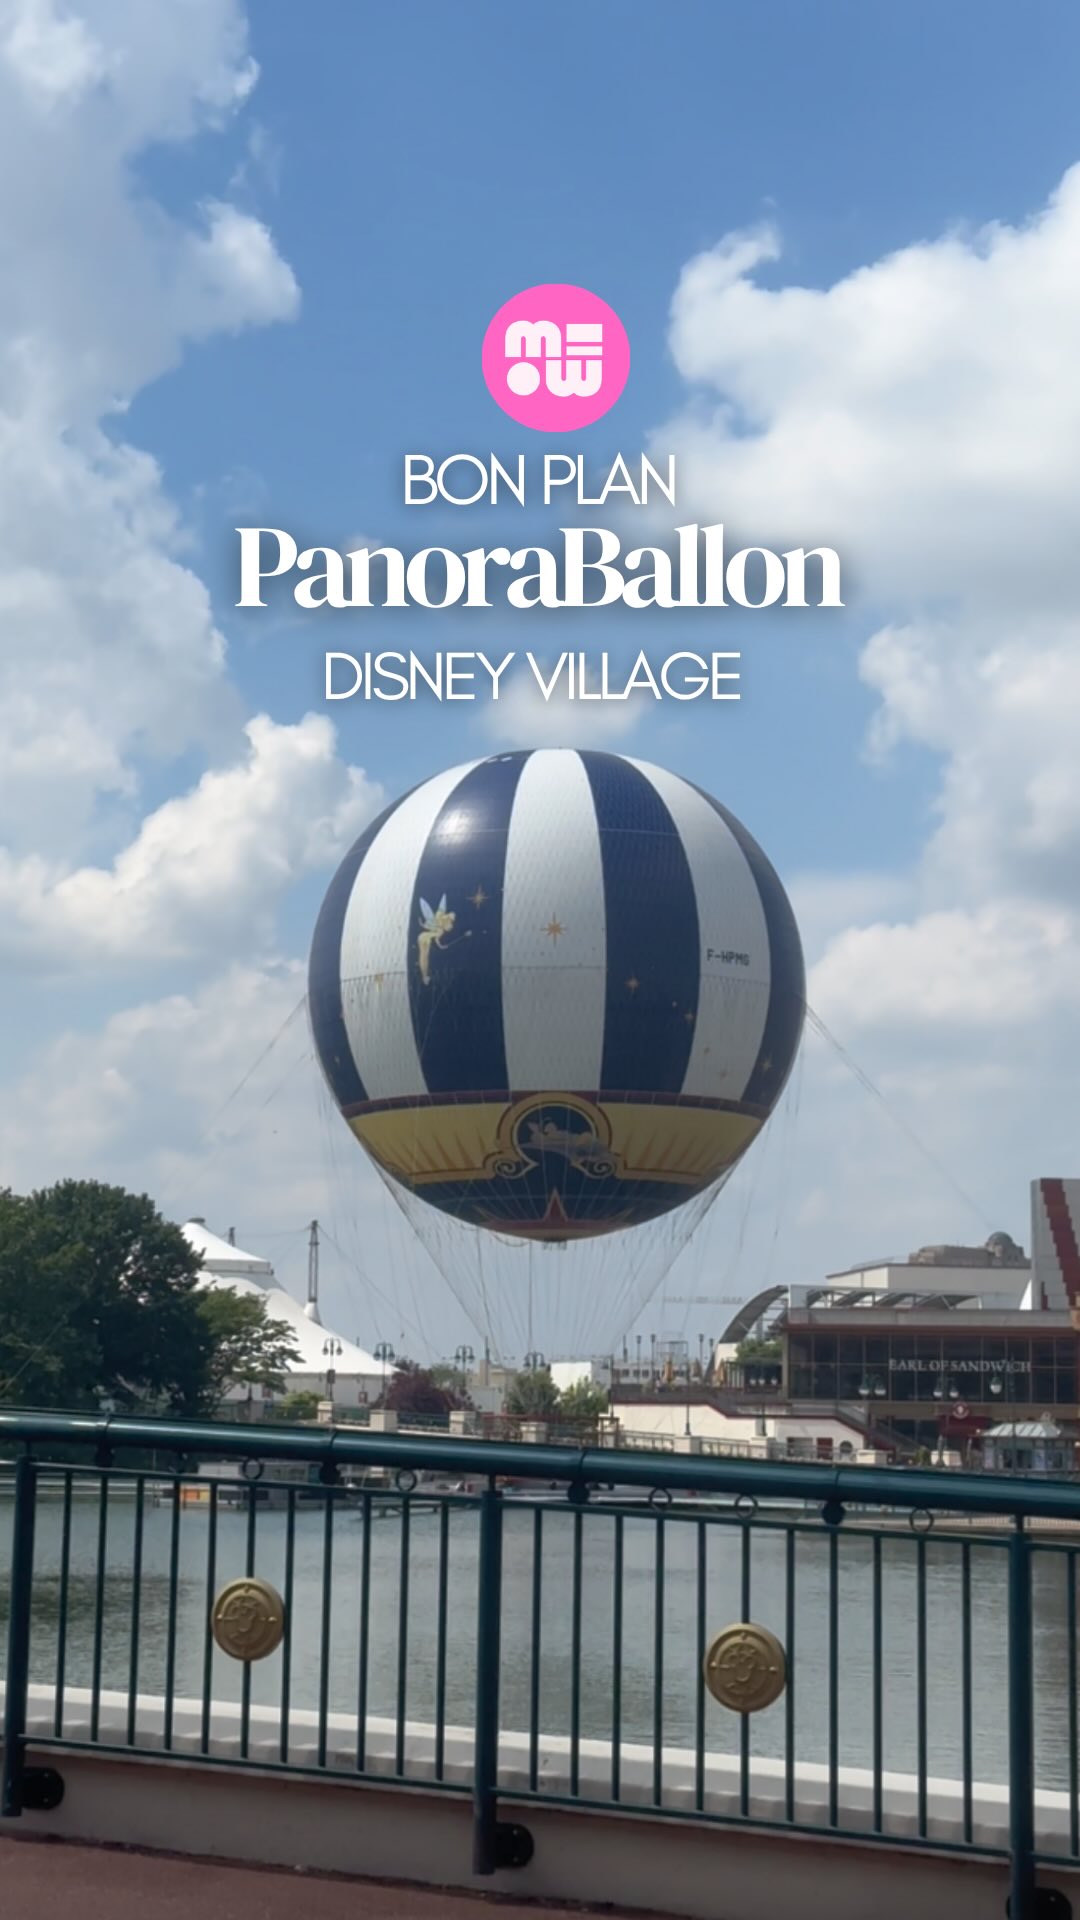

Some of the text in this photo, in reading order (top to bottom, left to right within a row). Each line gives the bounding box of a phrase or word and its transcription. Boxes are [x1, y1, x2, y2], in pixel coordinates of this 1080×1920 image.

[888, 1359, 1031, 1373] EARL OF SANDWICH
